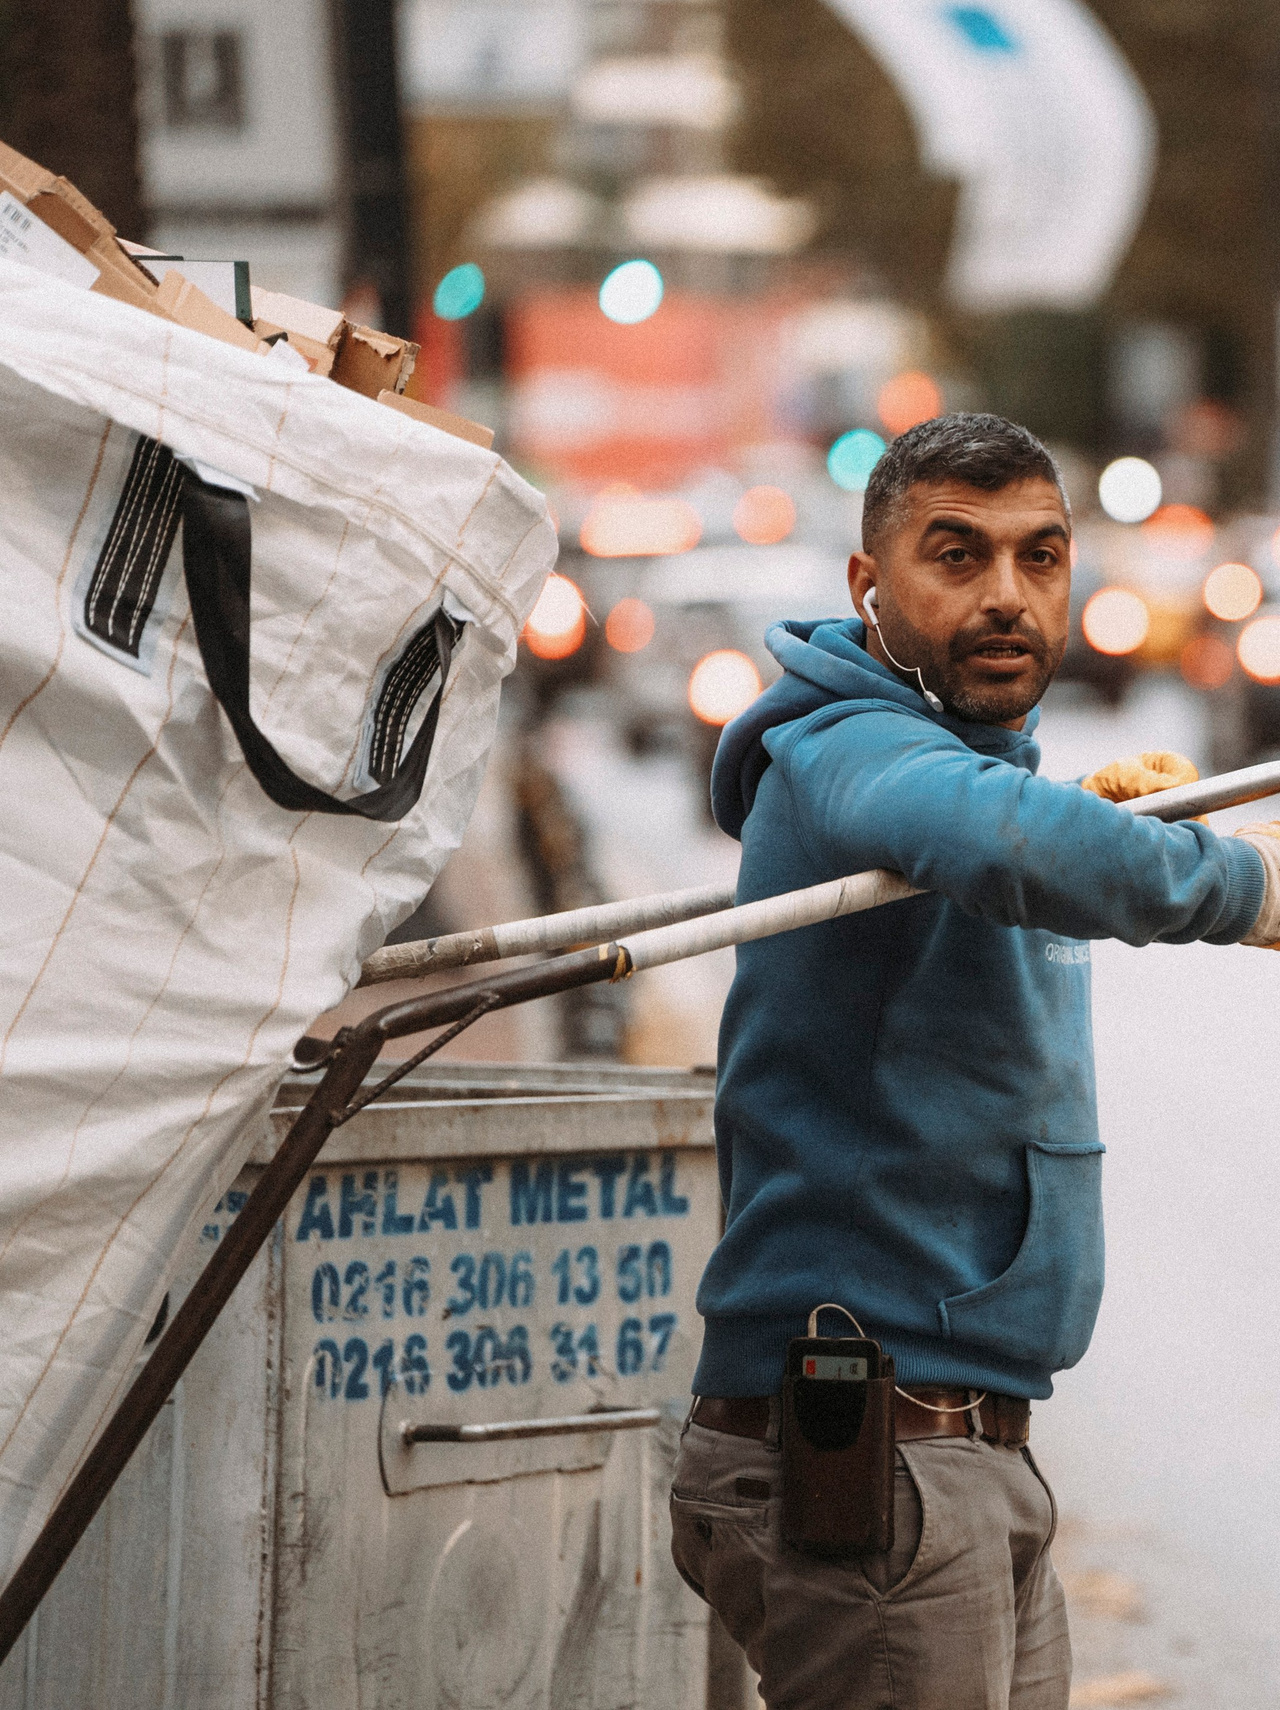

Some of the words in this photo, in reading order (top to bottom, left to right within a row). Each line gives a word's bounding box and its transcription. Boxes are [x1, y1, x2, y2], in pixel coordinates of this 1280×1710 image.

[296, 1164, 493, 1241] AHLAT
[510, 1153, 689, 1226] METAL
[312, 1256, 431, 1324] 0216
[447, 1251, 535, 1317] 306
[552, 1246, 600, 1306] 13
[617, 1240, 672, 1304] 50
[314, 1333, 431, 1401] 0216
[446, 1324, 532, 1393] 306
[550, 1321, 599, 1383] 31
[617, 1312, 676, 1377] 67
